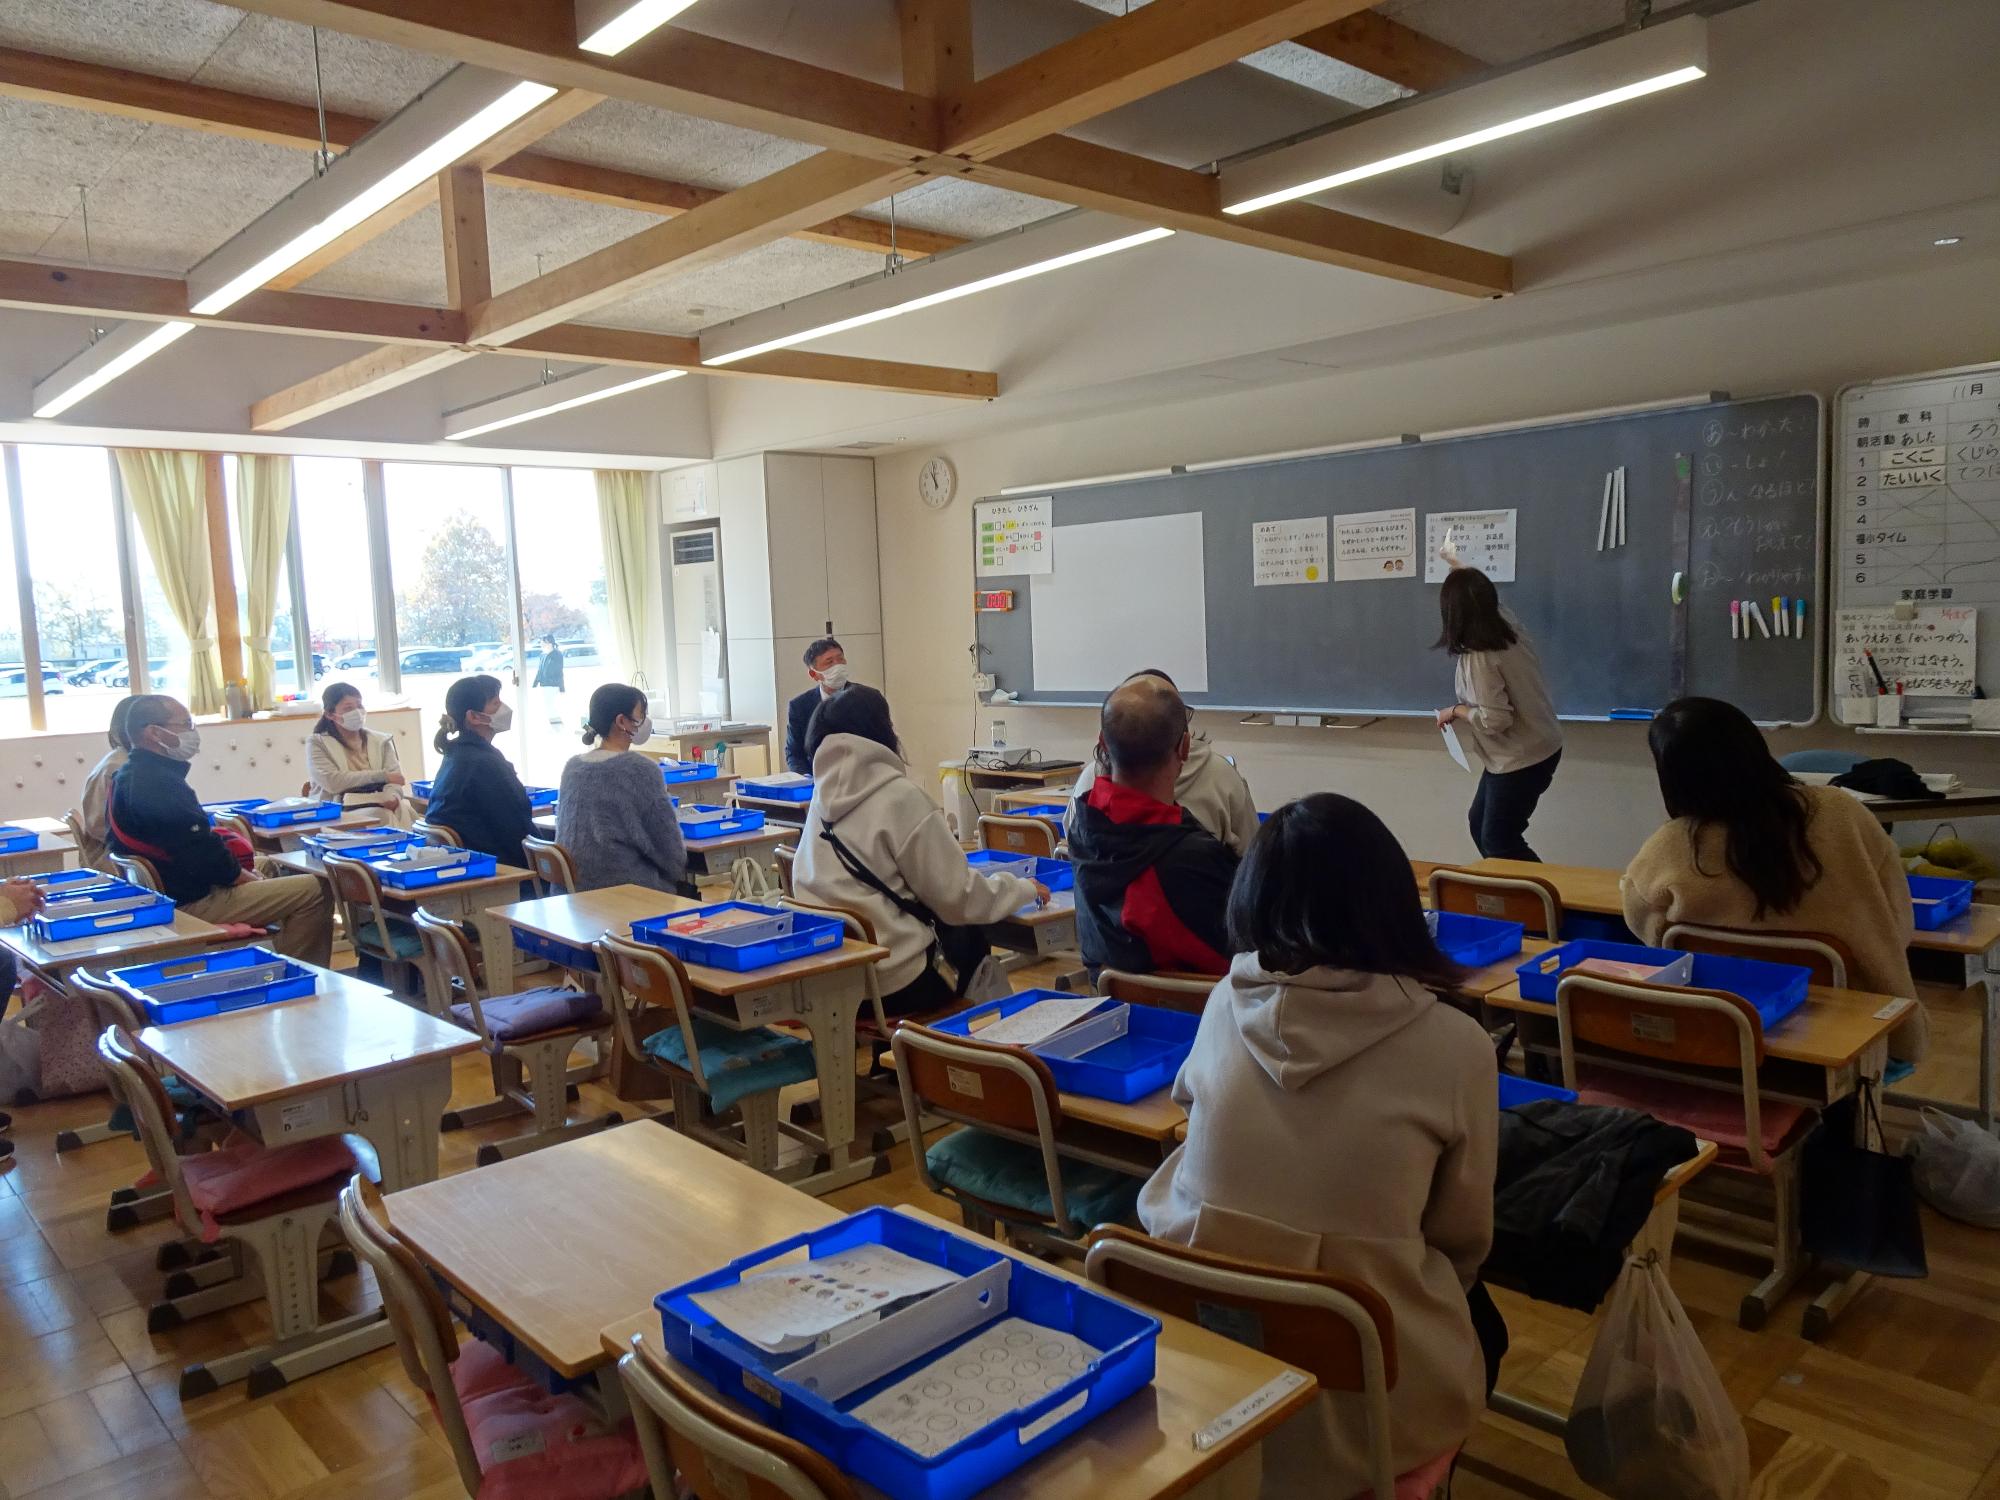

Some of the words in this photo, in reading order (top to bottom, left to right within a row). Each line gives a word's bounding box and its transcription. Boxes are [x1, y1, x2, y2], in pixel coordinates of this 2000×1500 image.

[1859, 457, 1865, 467] 1
[1856, 476, 1867, 487] 2
[1883, 469, 1942, 486] たいいく
[1856, 496, 1867, 507] 3
[1856, 515, 1867, 525] 4
[1856, 554, 1866, 565] 5
[1856, 572, 1866, 583] 6
[1901, 588, 1953, 600] 家庭学習
